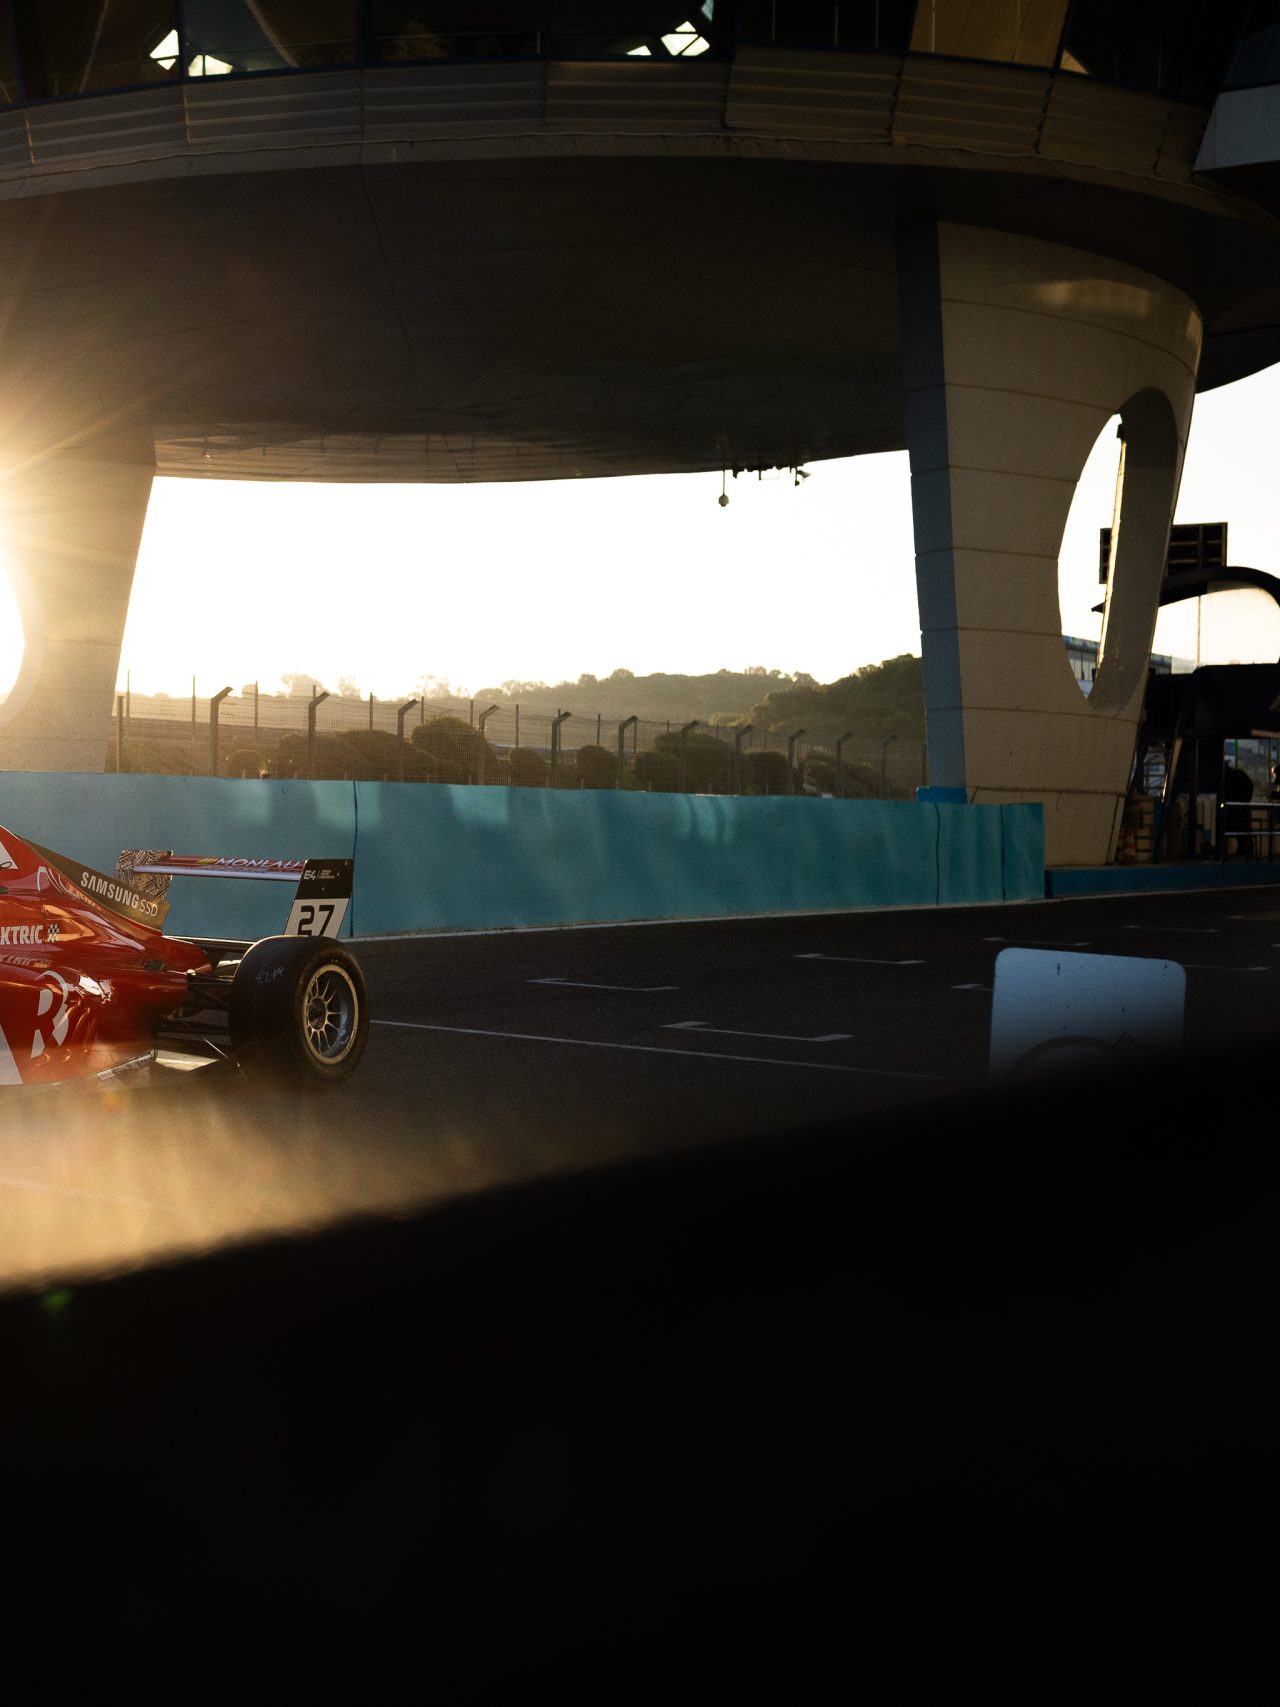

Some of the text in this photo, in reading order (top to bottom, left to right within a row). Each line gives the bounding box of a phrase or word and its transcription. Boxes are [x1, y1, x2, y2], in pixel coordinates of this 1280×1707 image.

[215, 857, 300, 869] MONLAU
[81, 872, 139, 909] SAMSUNG
[140, 899, 158, 917] SSD
[298, 904, 335, 936] 27
